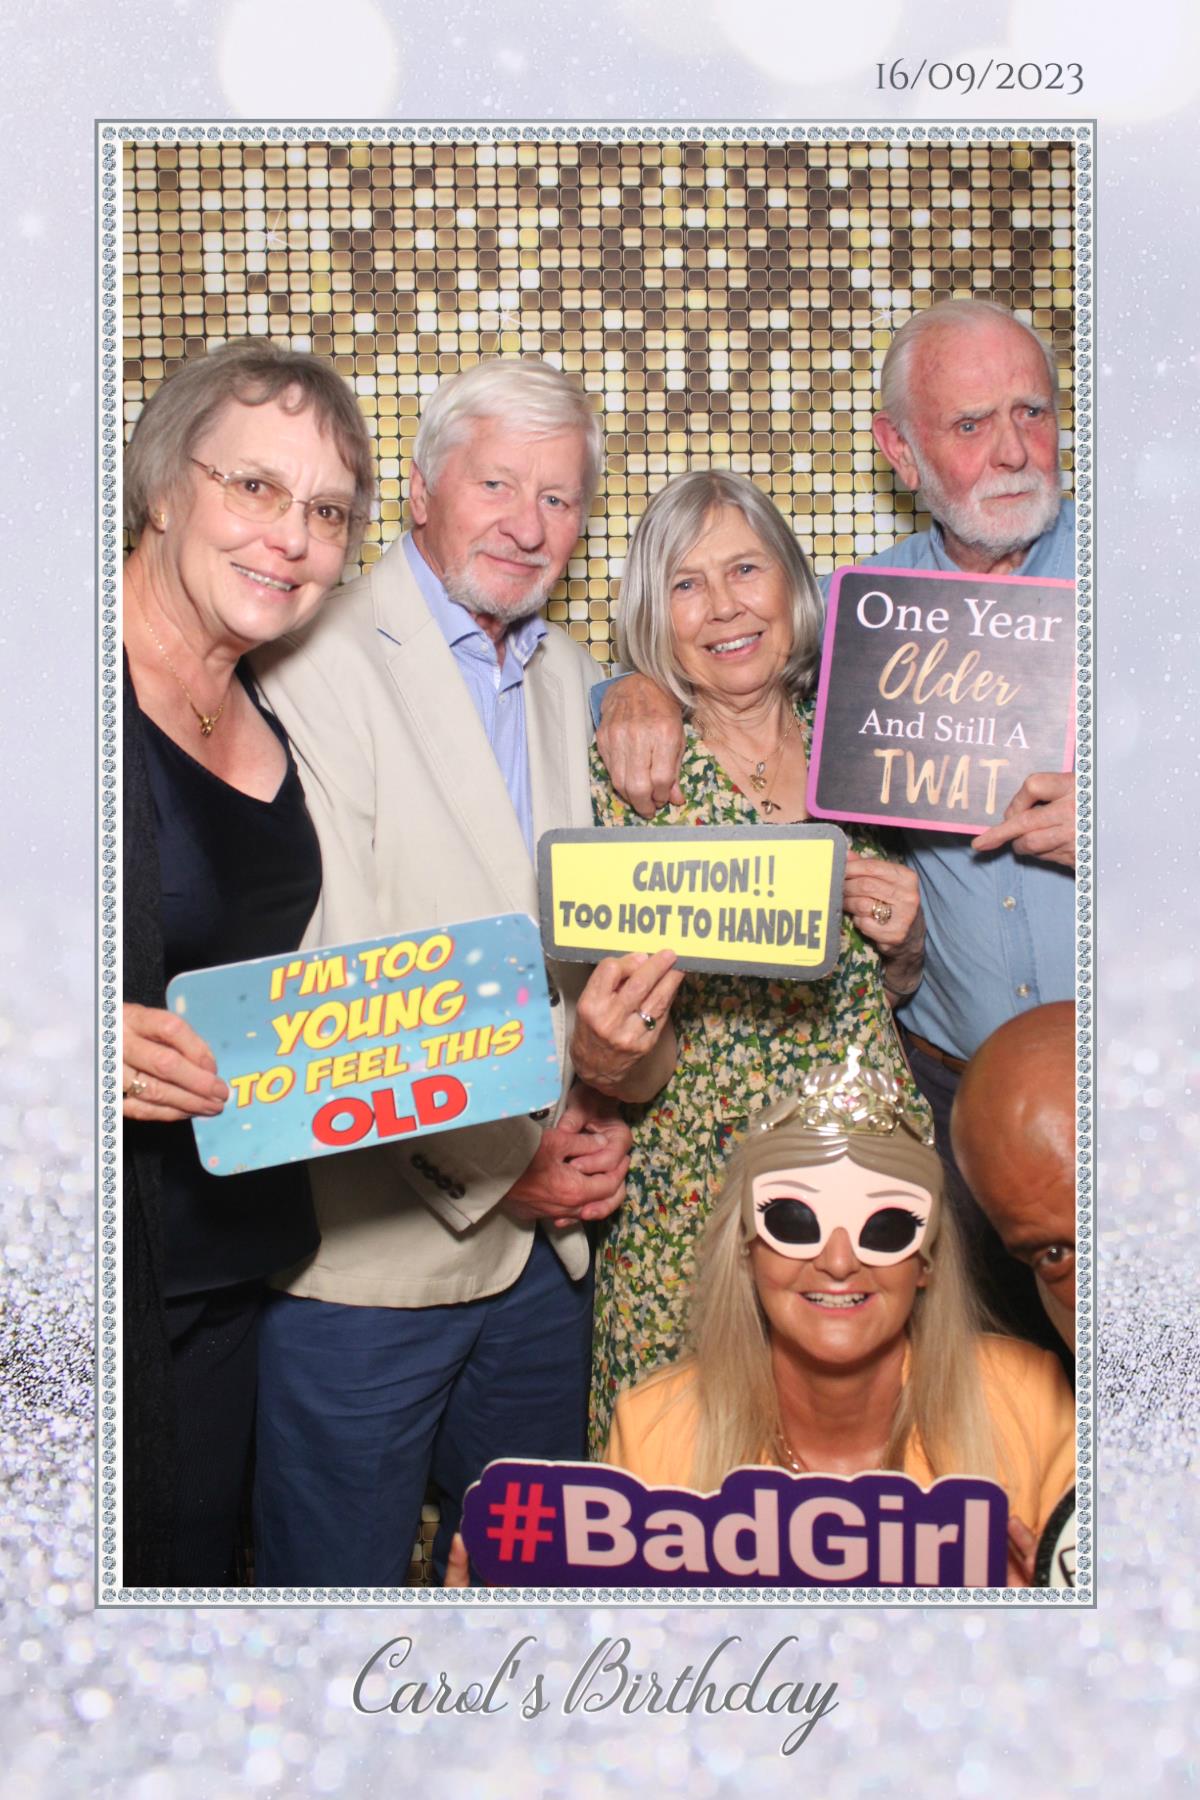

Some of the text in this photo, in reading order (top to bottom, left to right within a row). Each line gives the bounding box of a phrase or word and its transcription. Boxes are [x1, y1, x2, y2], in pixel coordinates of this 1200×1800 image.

[856, 591, 1063, 642] One Year
[878, 638, 1022, 706] Older
[859, 709, 1030, 749] And Still A
[873, 748, 1009, 815] TWAT
[632, 855, 776, 898] CAUTION!!
[559, 901, 823, 949] TOO HOT TO HANDLE
[270, 934, 455, 1002] I'M TOO
[271, 979, 466, 1057] YOUNG
[230, 1019, 524, 1108] TO FEEL THIS
[311, 1073, 468, 1147] OLD
[486, 1481, 991, 1587] #BadGirl
